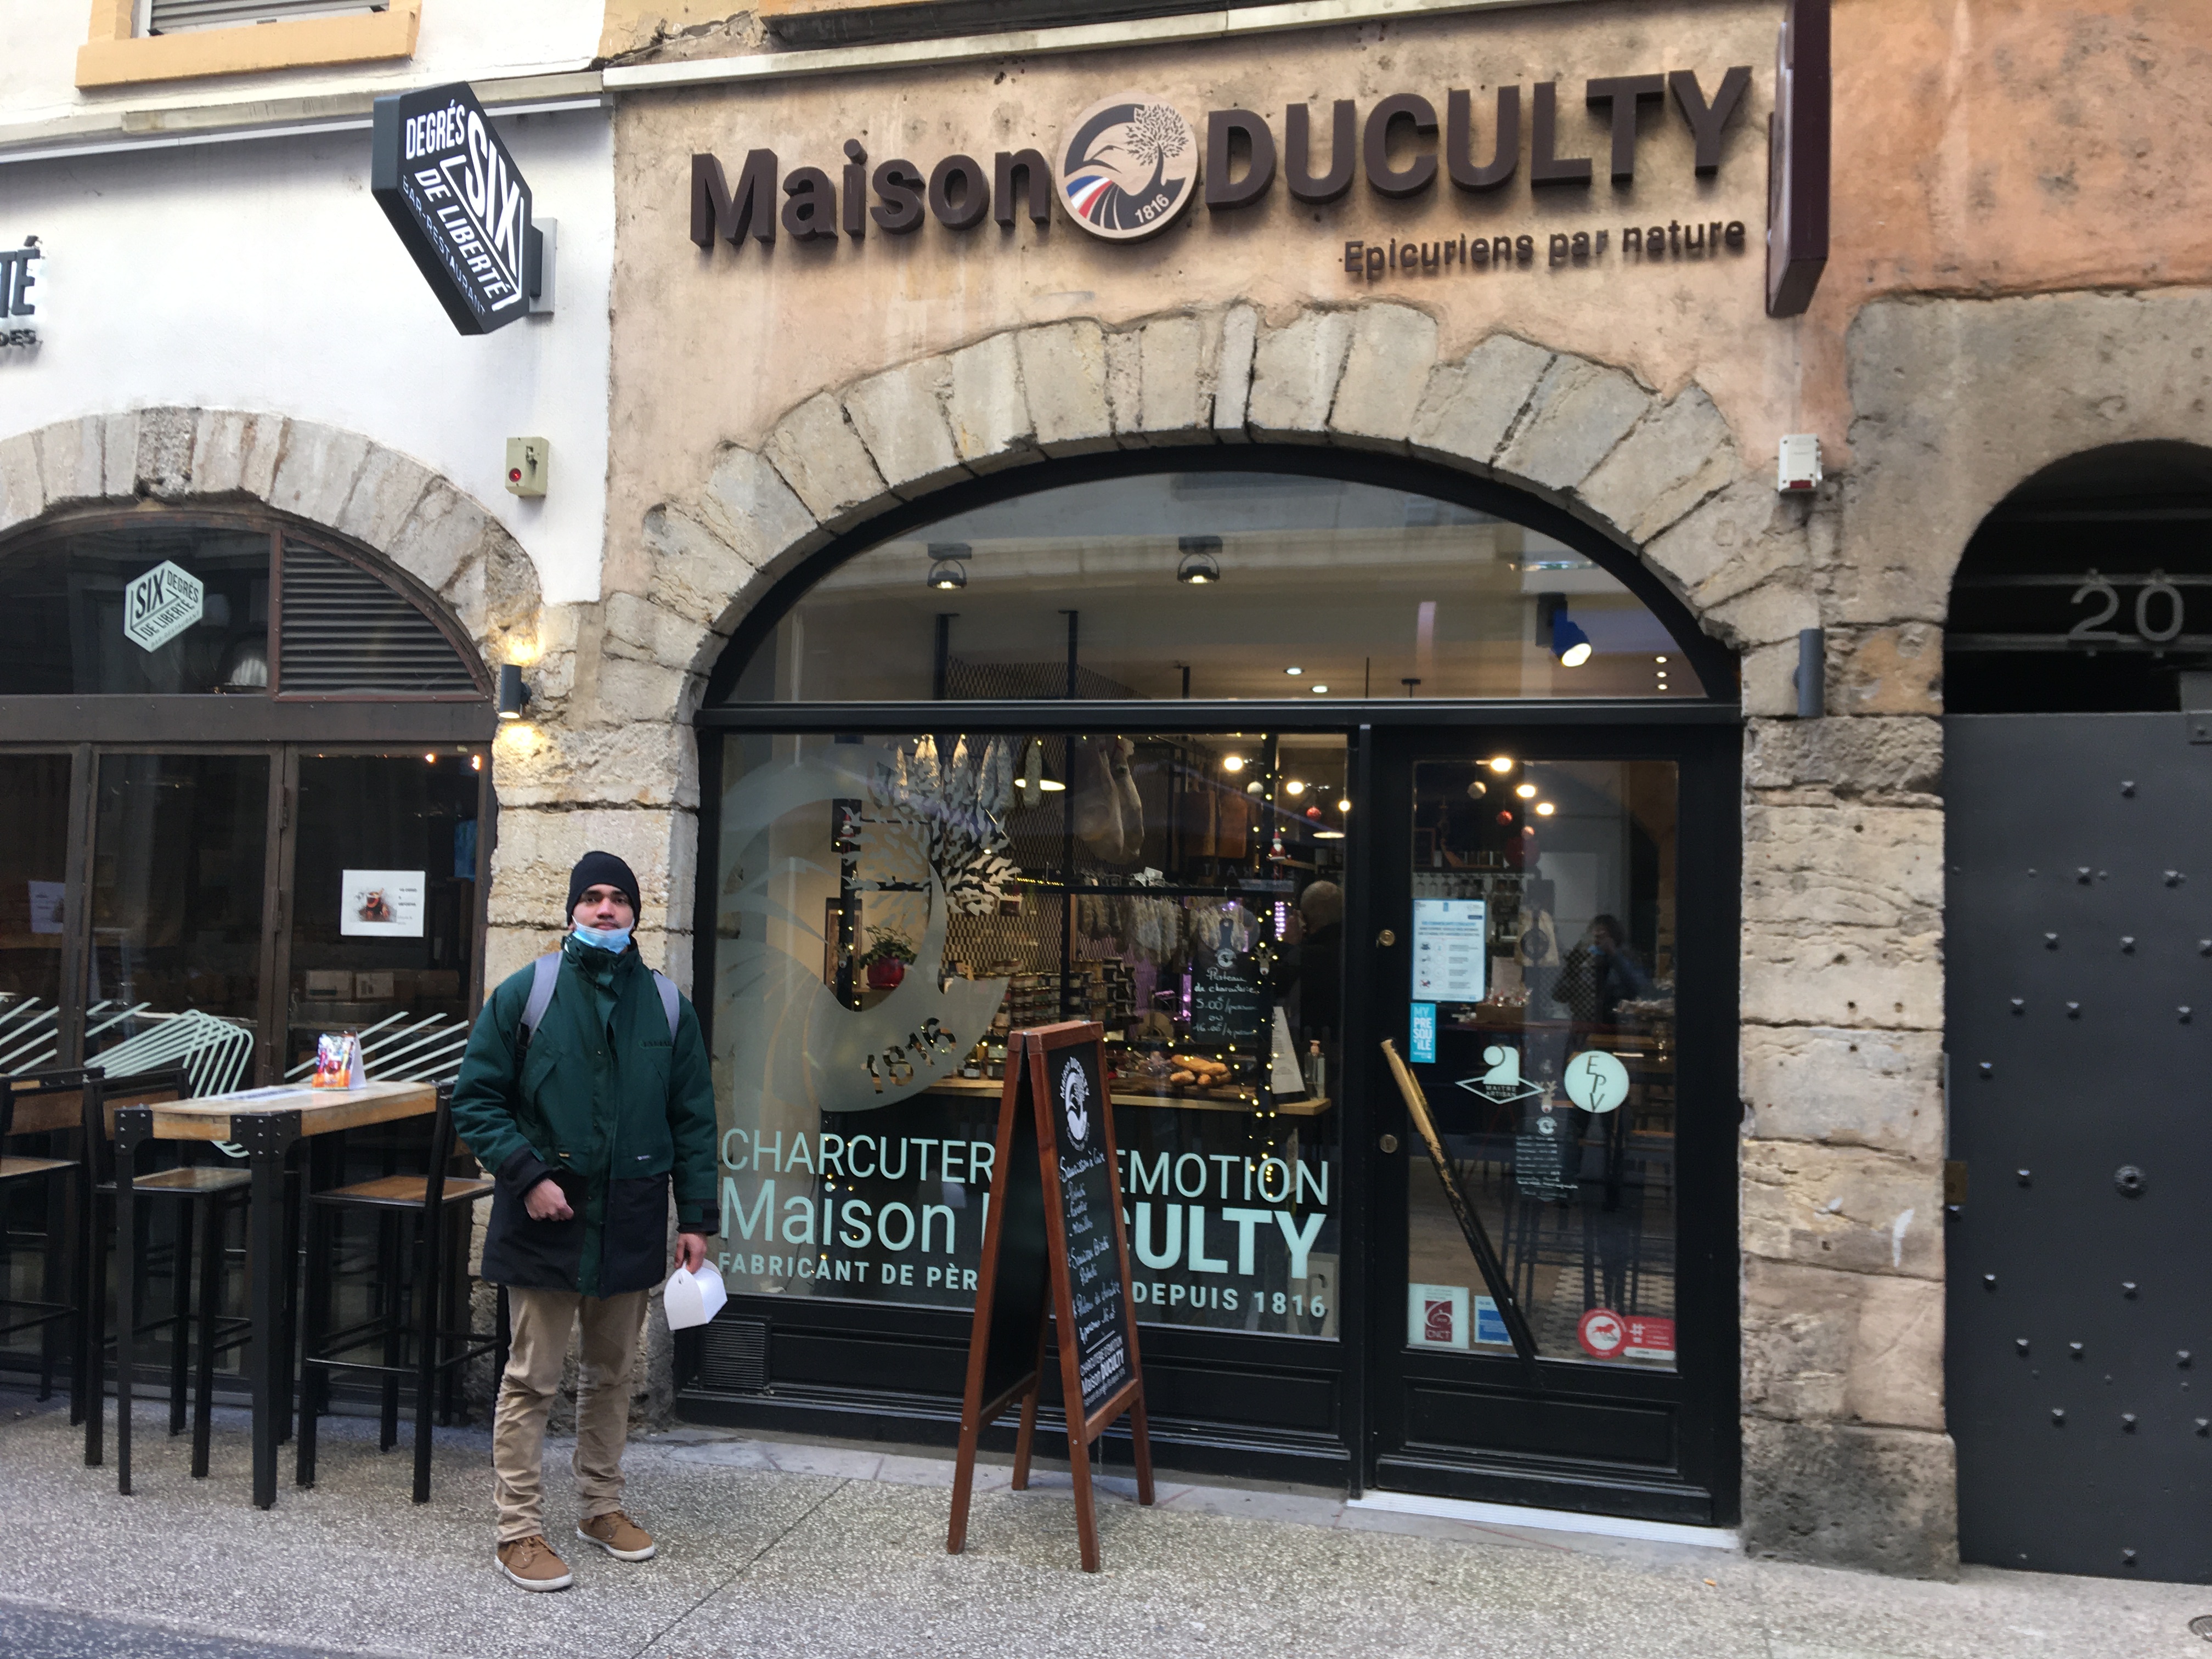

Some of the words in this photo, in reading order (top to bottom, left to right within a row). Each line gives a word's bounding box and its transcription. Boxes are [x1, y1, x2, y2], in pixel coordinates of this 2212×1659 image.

[405, 99, 466, 160] DEGRÉS
[690, 138, 1052, 247] Maison
[1205, 65, 1753, 212] DUCULTY
[465, 110, 520, 279] SIX
[1134, 193, 1169, 224] 1816
[402, 174, 486, 316] BAR-RESTAURANT
[414, 168, 452, 202] DE
[437, 205, 512, 300] LIBERTÉ
[1344, 233, 1534, 280] Epicuriens
[1548, 227, 1609, 267] par
[1622, 219, 1746, 256] nature
[135, 568, 165, 620] SIX
[139, 622, 160, 637] DE
[153, 598, 195, 629] LIBERTÉ
[166, 569, 199, 604] DEGRÉS
[2068, 582, 2185, 642] 20
[860, 1017, 946, 1094] 1816
[720, 1176, 955, 1254] Maison
[1122, 1201, 1327, 1280] ULTY
[718, 1251, 870, 1283] FABRICANT
[881, 1263, 915, 1286] DE
[1132, 1281, 1239, 1311] DEPUIS
[1254, 1291, 1326, 1318] 1816
